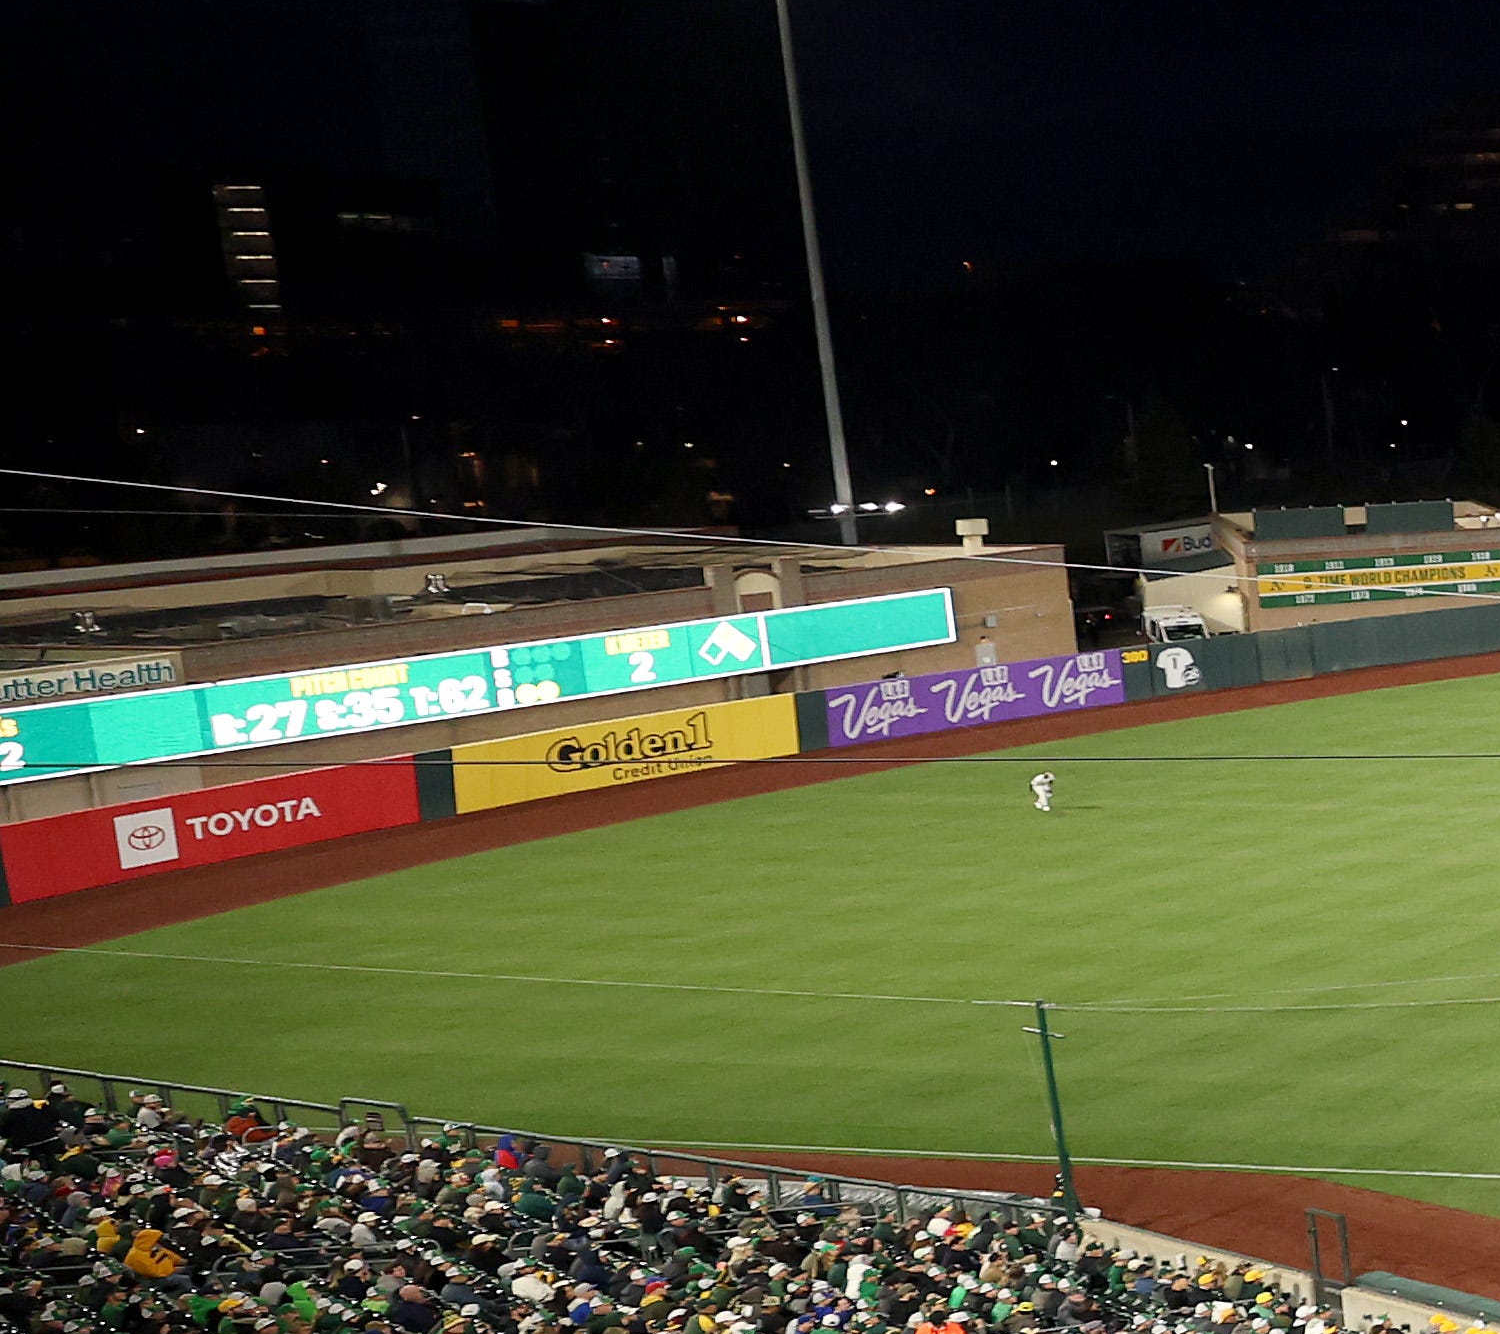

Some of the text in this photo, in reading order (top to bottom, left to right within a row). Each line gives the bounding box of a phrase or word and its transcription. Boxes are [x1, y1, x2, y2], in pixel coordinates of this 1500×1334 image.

[1318, 574, 1347, 587] TIME
[1350, 571, 1392, 586] WORLD
[1394, 567, 1466, 583] CHAMPIONS
[73, 660, 176, 691] Health
[629, 652, 656, 683] 2
[1029, 660, 1120, 708] Vegas
[829, 687, 928, 739] Vegas
[931, 673, 1025, 723] Vegas
[613, 754, 713, 780] Credit Union
[186, 797, 321, 839] TOYOTA
